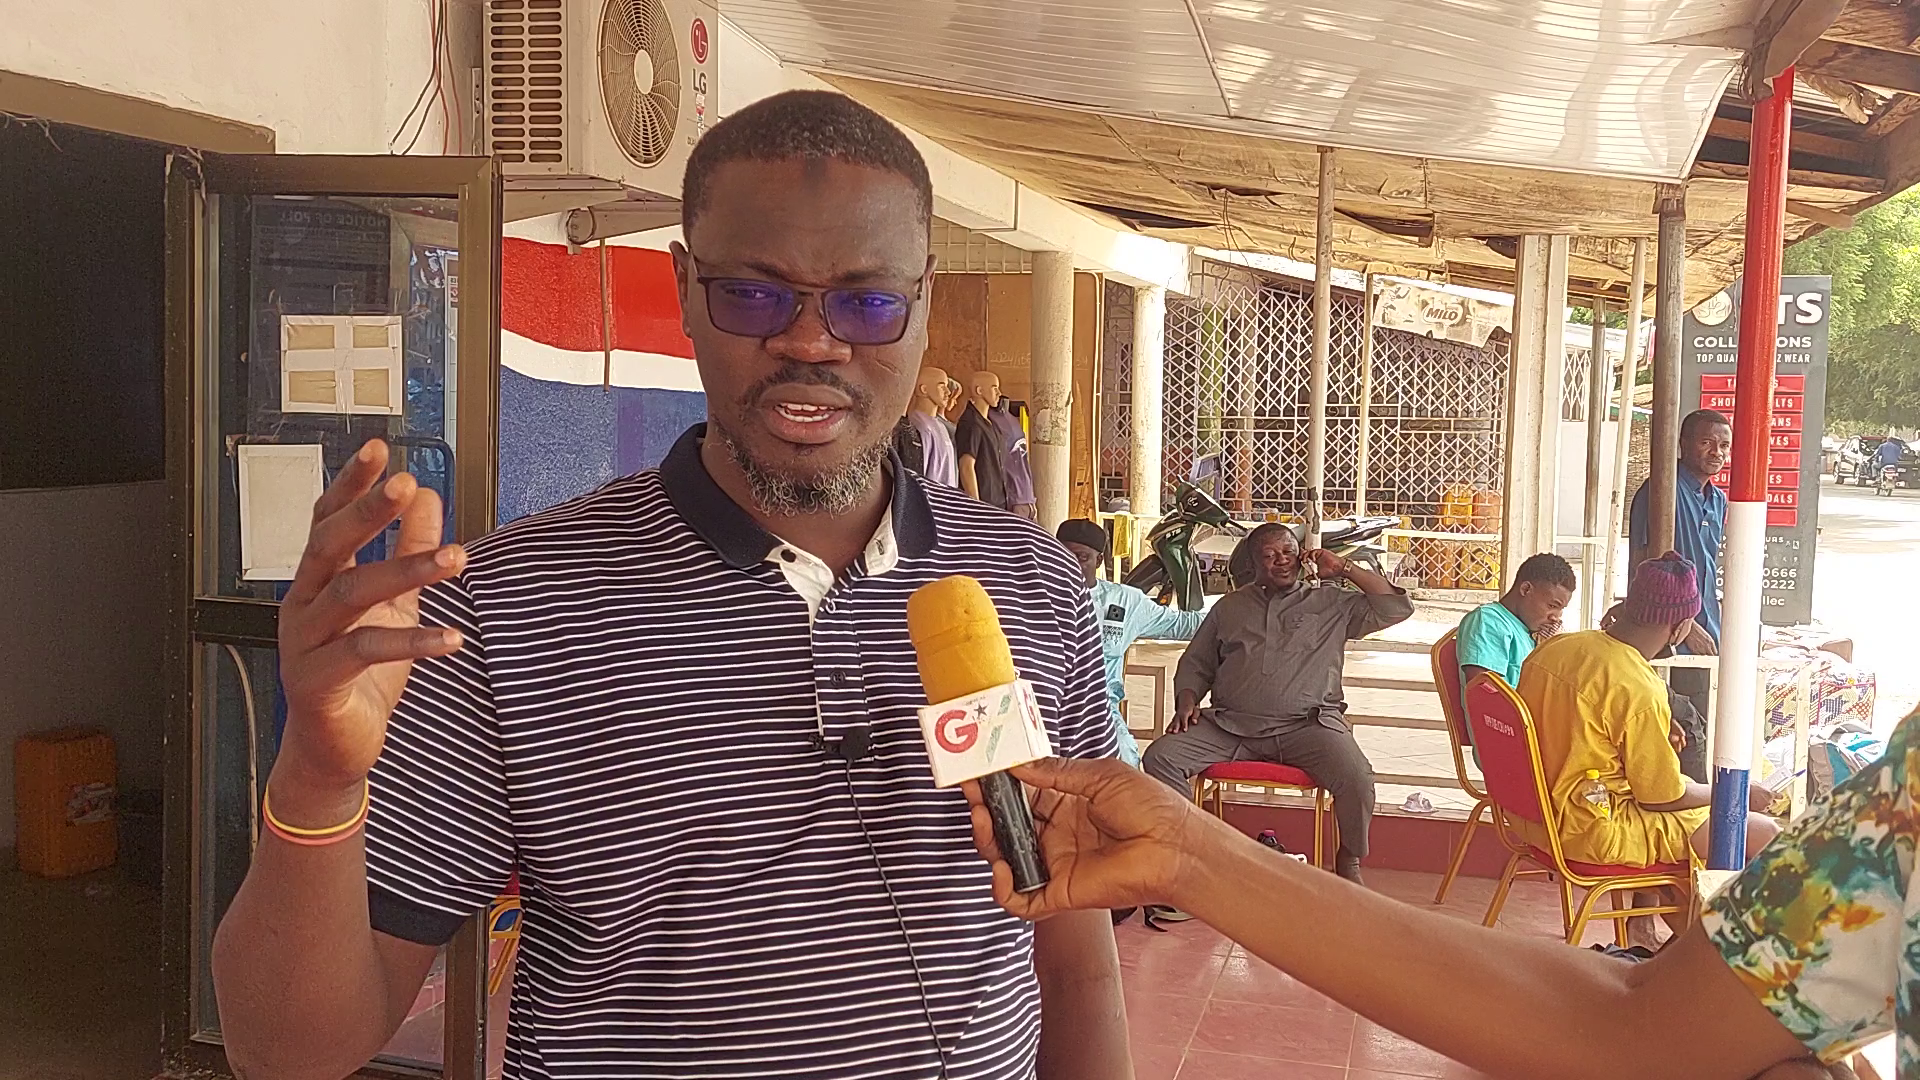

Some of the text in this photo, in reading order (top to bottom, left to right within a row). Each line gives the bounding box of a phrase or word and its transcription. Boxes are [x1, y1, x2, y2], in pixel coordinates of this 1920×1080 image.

[692, 68, 707, 95] LG
[1425, 308, 1459, 321] MILO
[1693, 336, 1812, 349] COLLONS
[1696, 353, 1714, 363] TOP
[1784, 354, 1811, 363] WEAR
